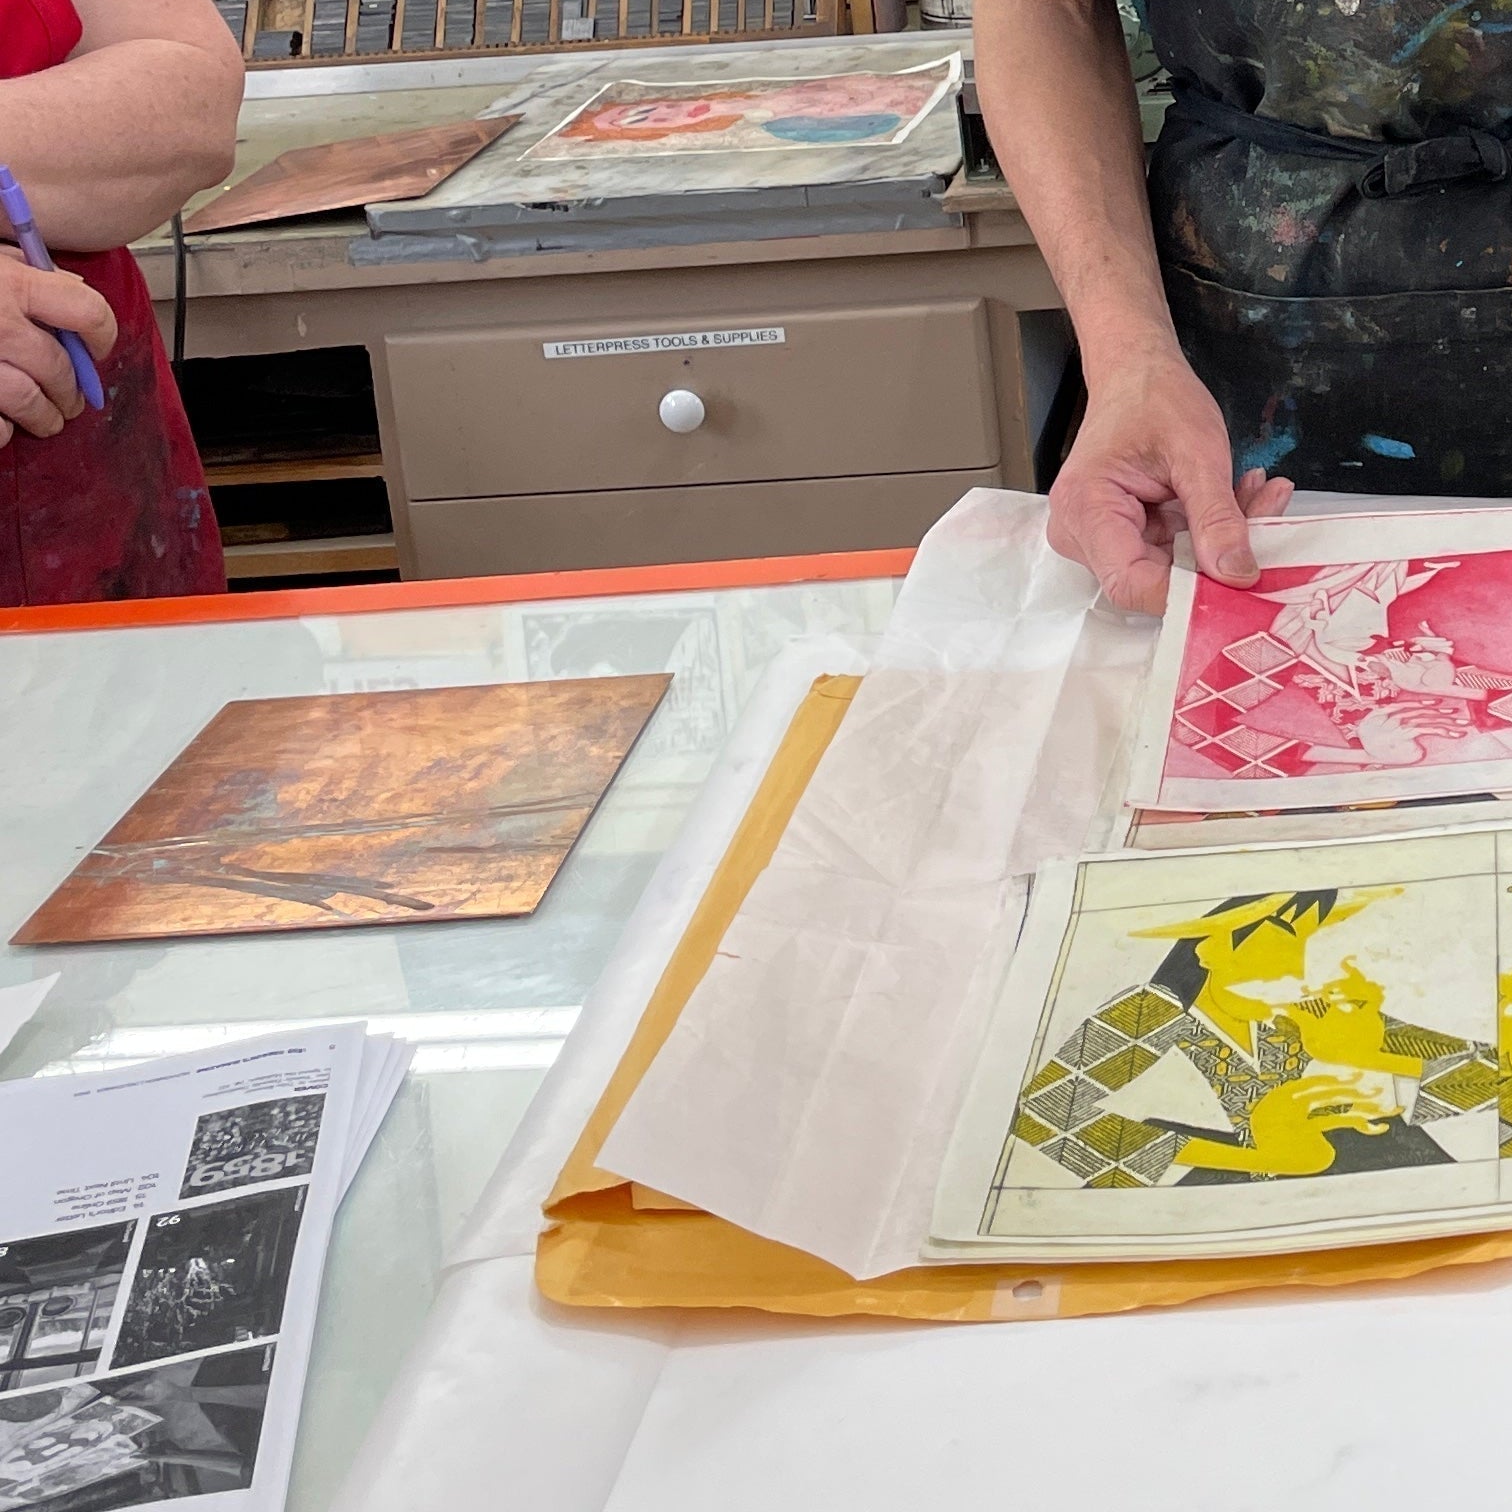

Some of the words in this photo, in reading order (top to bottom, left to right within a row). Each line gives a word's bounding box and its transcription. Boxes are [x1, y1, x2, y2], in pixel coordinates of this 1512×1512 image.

[555, 339, 650, 356] LETTERPRESS
[653, 335, 697, 349] TOOLS
[701, 335, 710, 345] &
[713, 330, 778, 345] SUPPLIES
[190, 1150, 306, 1187] 1859
[54, 1194, 92, 1204] Oregon
[89, 1206, 126, 1217] Editor's
[156, 1215, 181, 1227] 92
